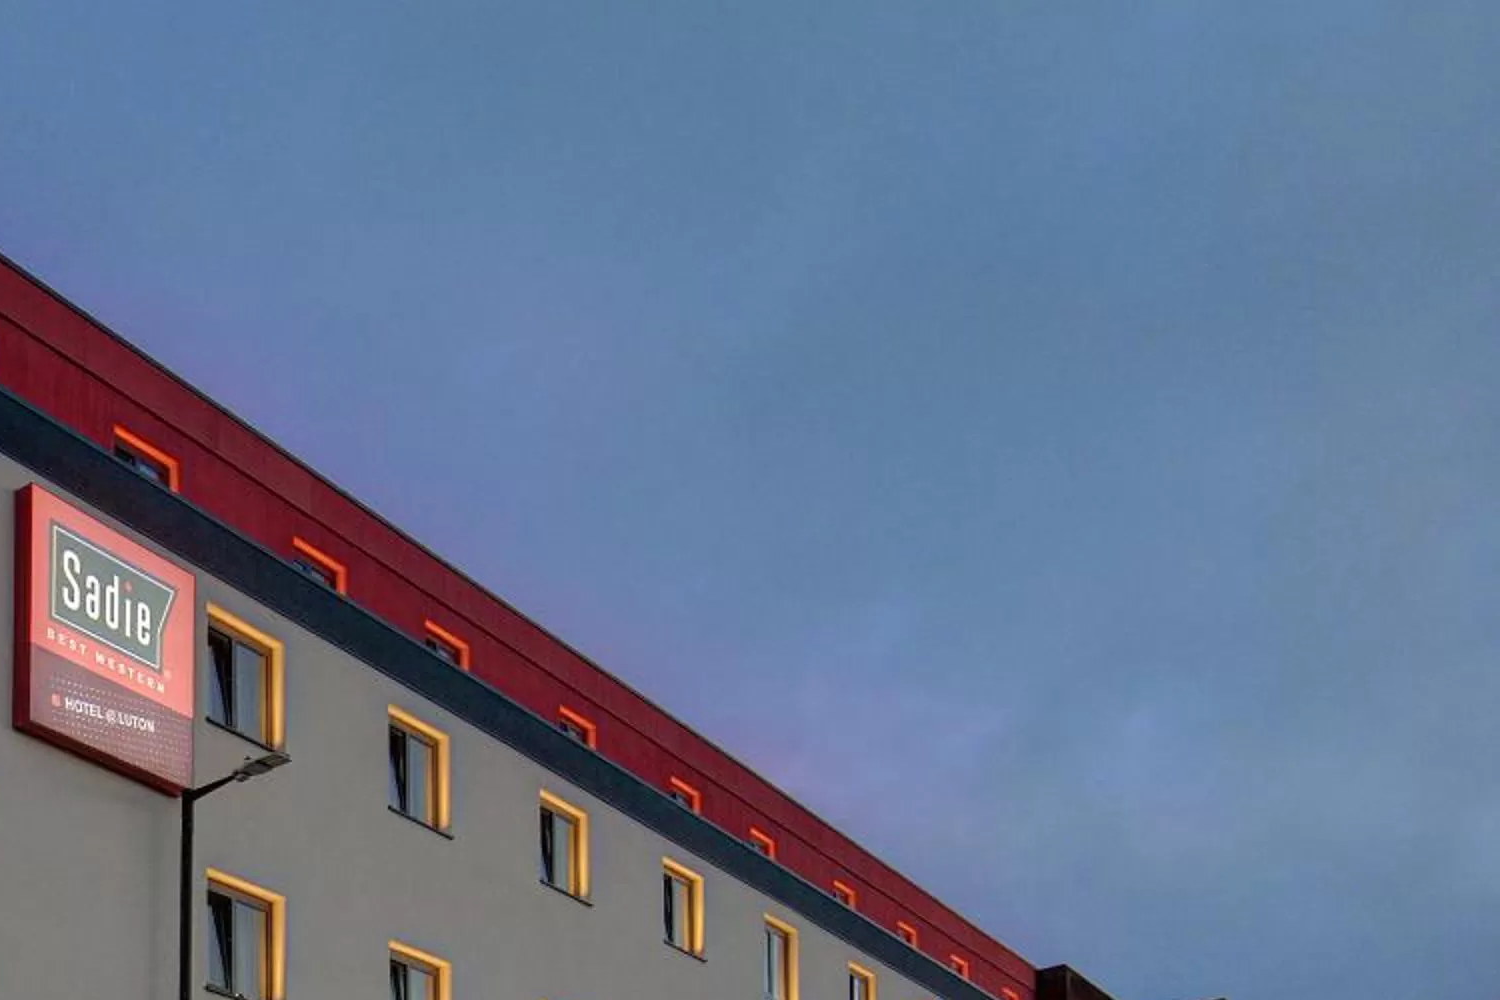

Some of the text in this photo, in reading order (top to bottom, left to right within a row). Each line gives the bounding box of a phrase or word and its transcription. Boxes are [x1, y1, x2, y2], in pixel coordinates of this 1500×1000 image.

[62, 549, 151, 646] Sadie
[46, 627, 165, 693] BEST WESTERN
[64, 696, 104, 719] HOTEL
